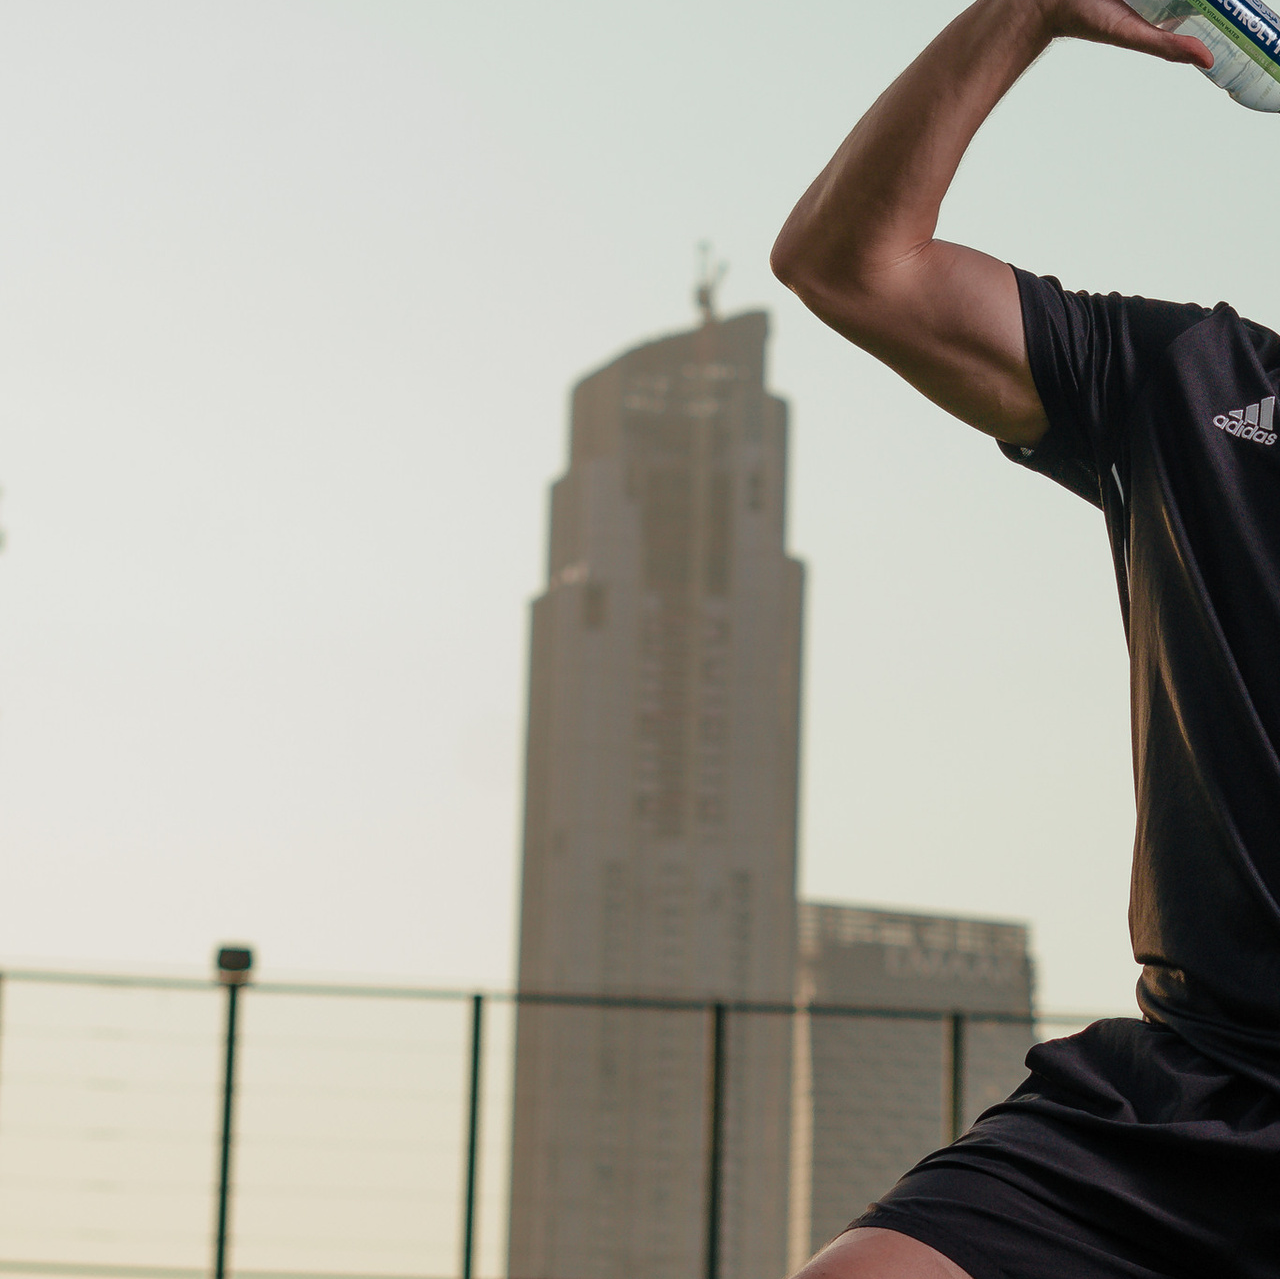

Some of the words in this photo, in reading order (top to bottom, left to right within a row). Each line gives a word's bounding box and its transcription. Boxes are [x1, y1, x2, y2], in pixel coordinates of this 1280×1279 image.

[1206, 9, 1225, 27] VITAMIN
[1223, 24, 1240, 40] WATER
[1212, 413, 1278, 446] adidas
